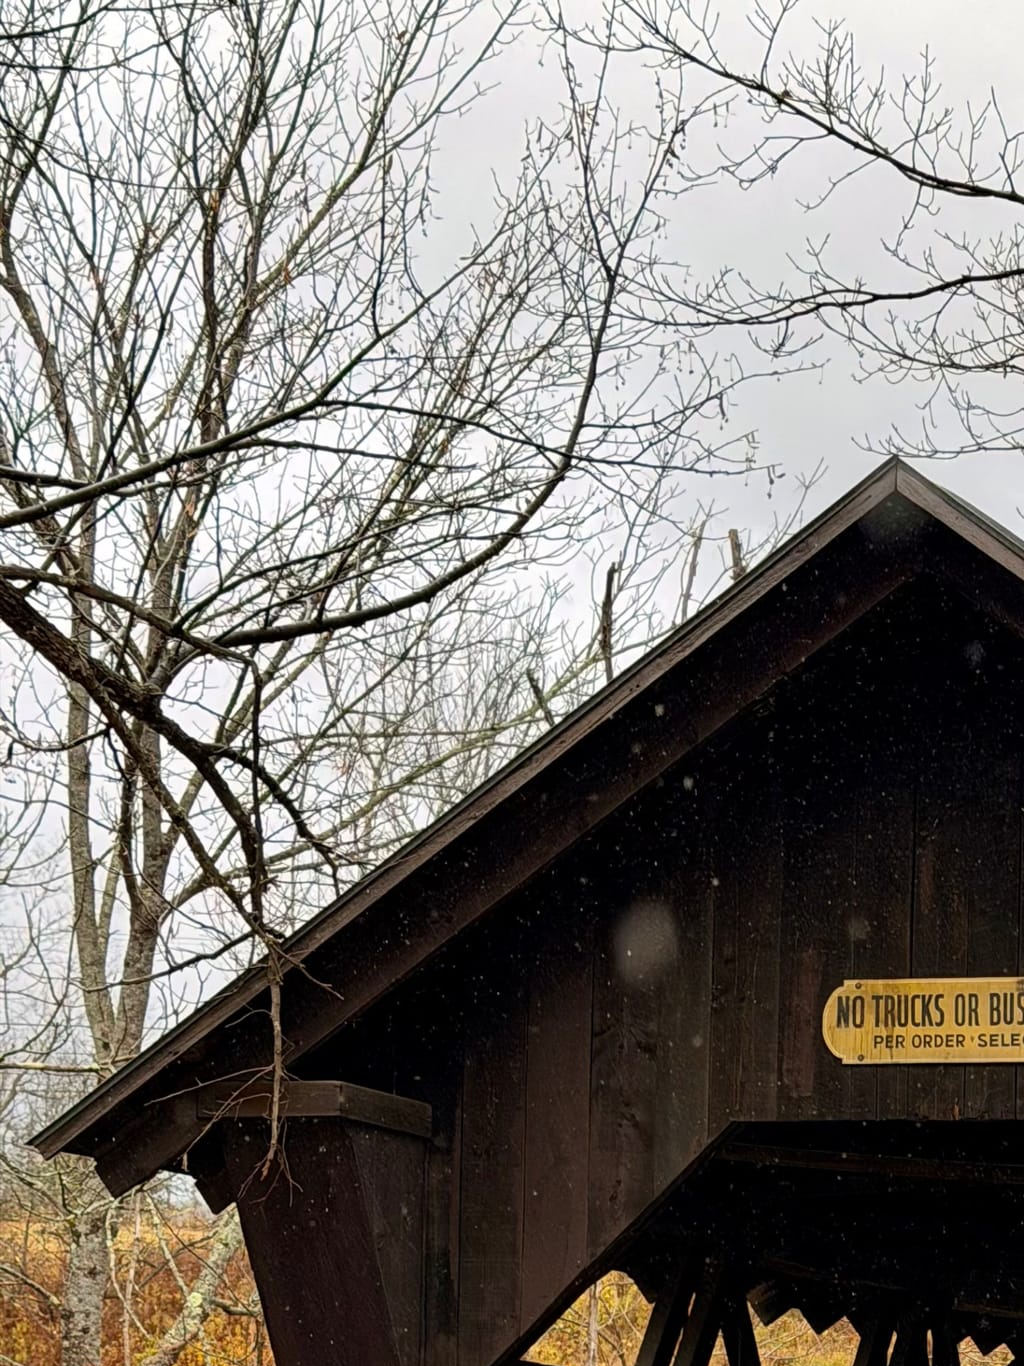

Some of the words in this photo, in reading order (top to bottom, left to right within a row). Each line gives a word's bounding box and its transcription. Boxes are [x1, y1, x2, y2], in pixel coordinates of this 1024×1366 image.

[837, 995, 864, 1028] NO
[872, 994, 945, 1027] TRUCKS
[954, 993, 980, 1026] OR
[873, 1035, 905, 1049] PER
[912, 1034, 965, 1048] ORDER
